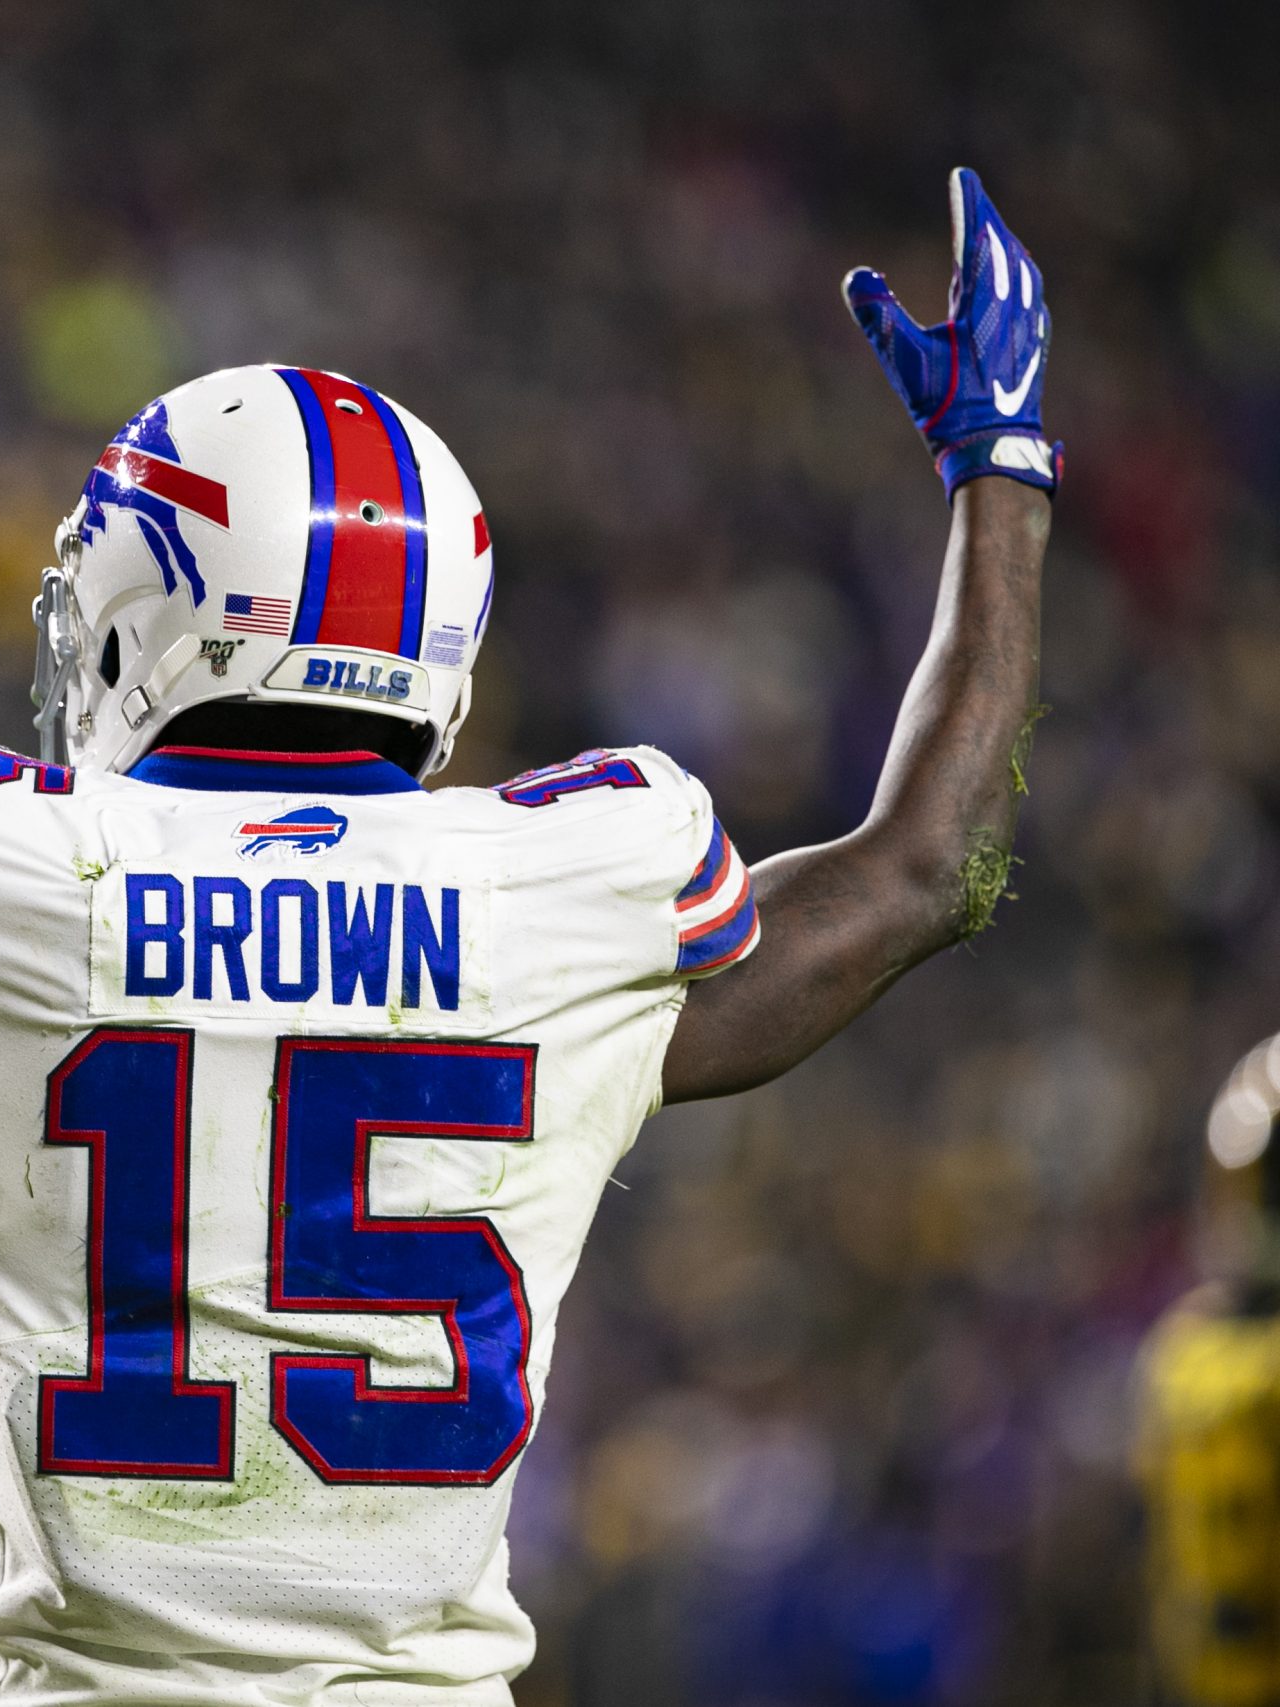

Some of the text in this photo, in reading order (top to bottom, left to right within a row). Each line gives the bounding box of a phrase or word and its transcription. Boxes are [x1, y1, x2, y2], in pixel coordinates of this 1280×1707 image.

[303, 658, 413, 699] BILLS
[125, 873, 460, 1011] BROWN
[37, 1025, 539, 1487] 15
